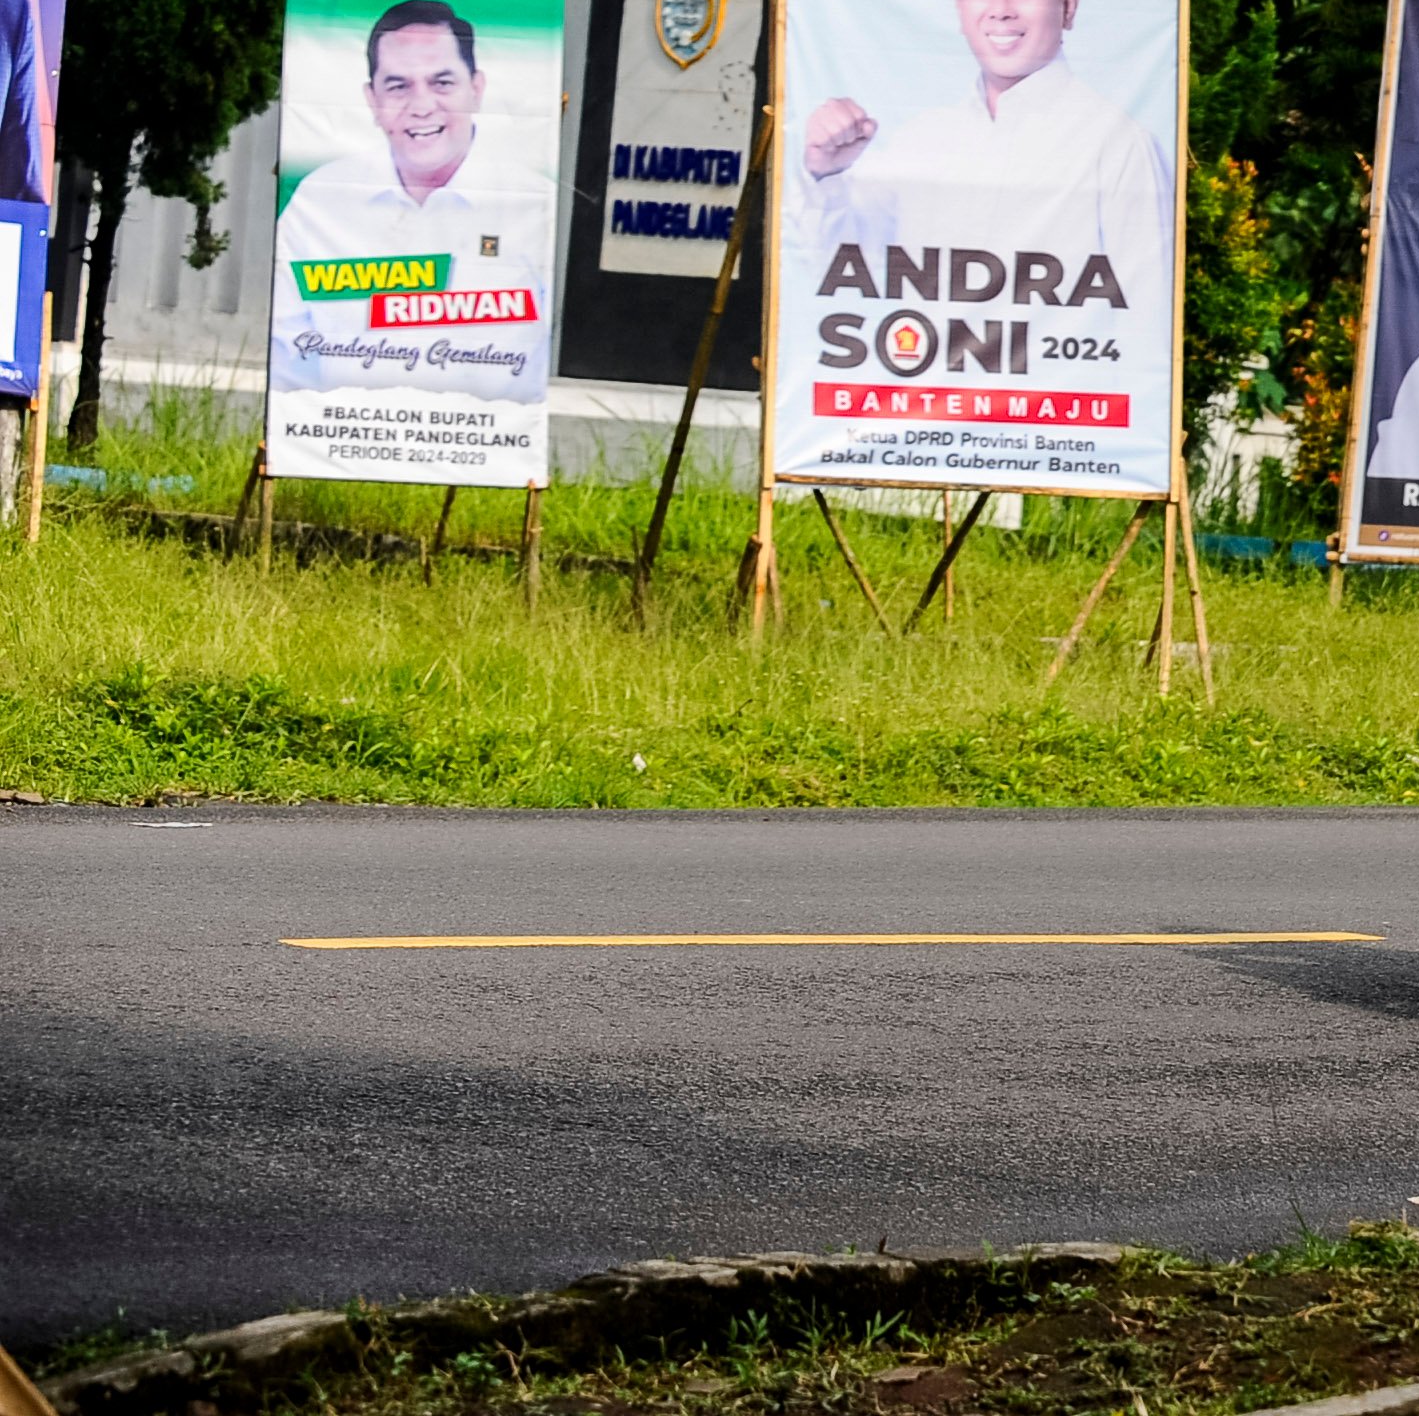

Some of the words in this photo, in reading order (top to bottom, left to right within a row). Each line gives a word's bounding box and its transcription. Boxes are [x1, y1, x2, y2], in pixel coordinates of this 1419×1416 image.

[611, 198, 736, 242] PANDEGLANG
[302, 260, 435, 293] WAWAN
[815, 243, 1129, 309] ANDRA
[384, 291, 526, 324] RIDWAN
[292, 330, 421, 372] Pandeglang
[426, 338, 528, 376] Gemilang
[817, 309, 1029, 378] SONI
[1041, 336, 1121, 363] 2024
[323, 406, 423, 425] #BACALON
[430, 412, 495, 428] BUPATI
[834, 388, 993, 416] BANTEN
[1008, 395, 1109, 422] MAJU
[285, 423, 399, 443] KABUPATEN
[404, 429, 531, 449] PANDEGLANG
[904, 431, 954, 447] DPRD
[961, 433, 1029, 451] Provinsi
[1036, 436, 1096, 453] Banten
[328, 445, 402, 462] PERIODE
[408, 449, 487, 466] 2024-2029
[820, 448, 874, 465] Bakal
[882, 451, 937, 468] Calon
[945, 453, 1040, 472] Gubernur
[1048, 458, 1121, 475] Banten
